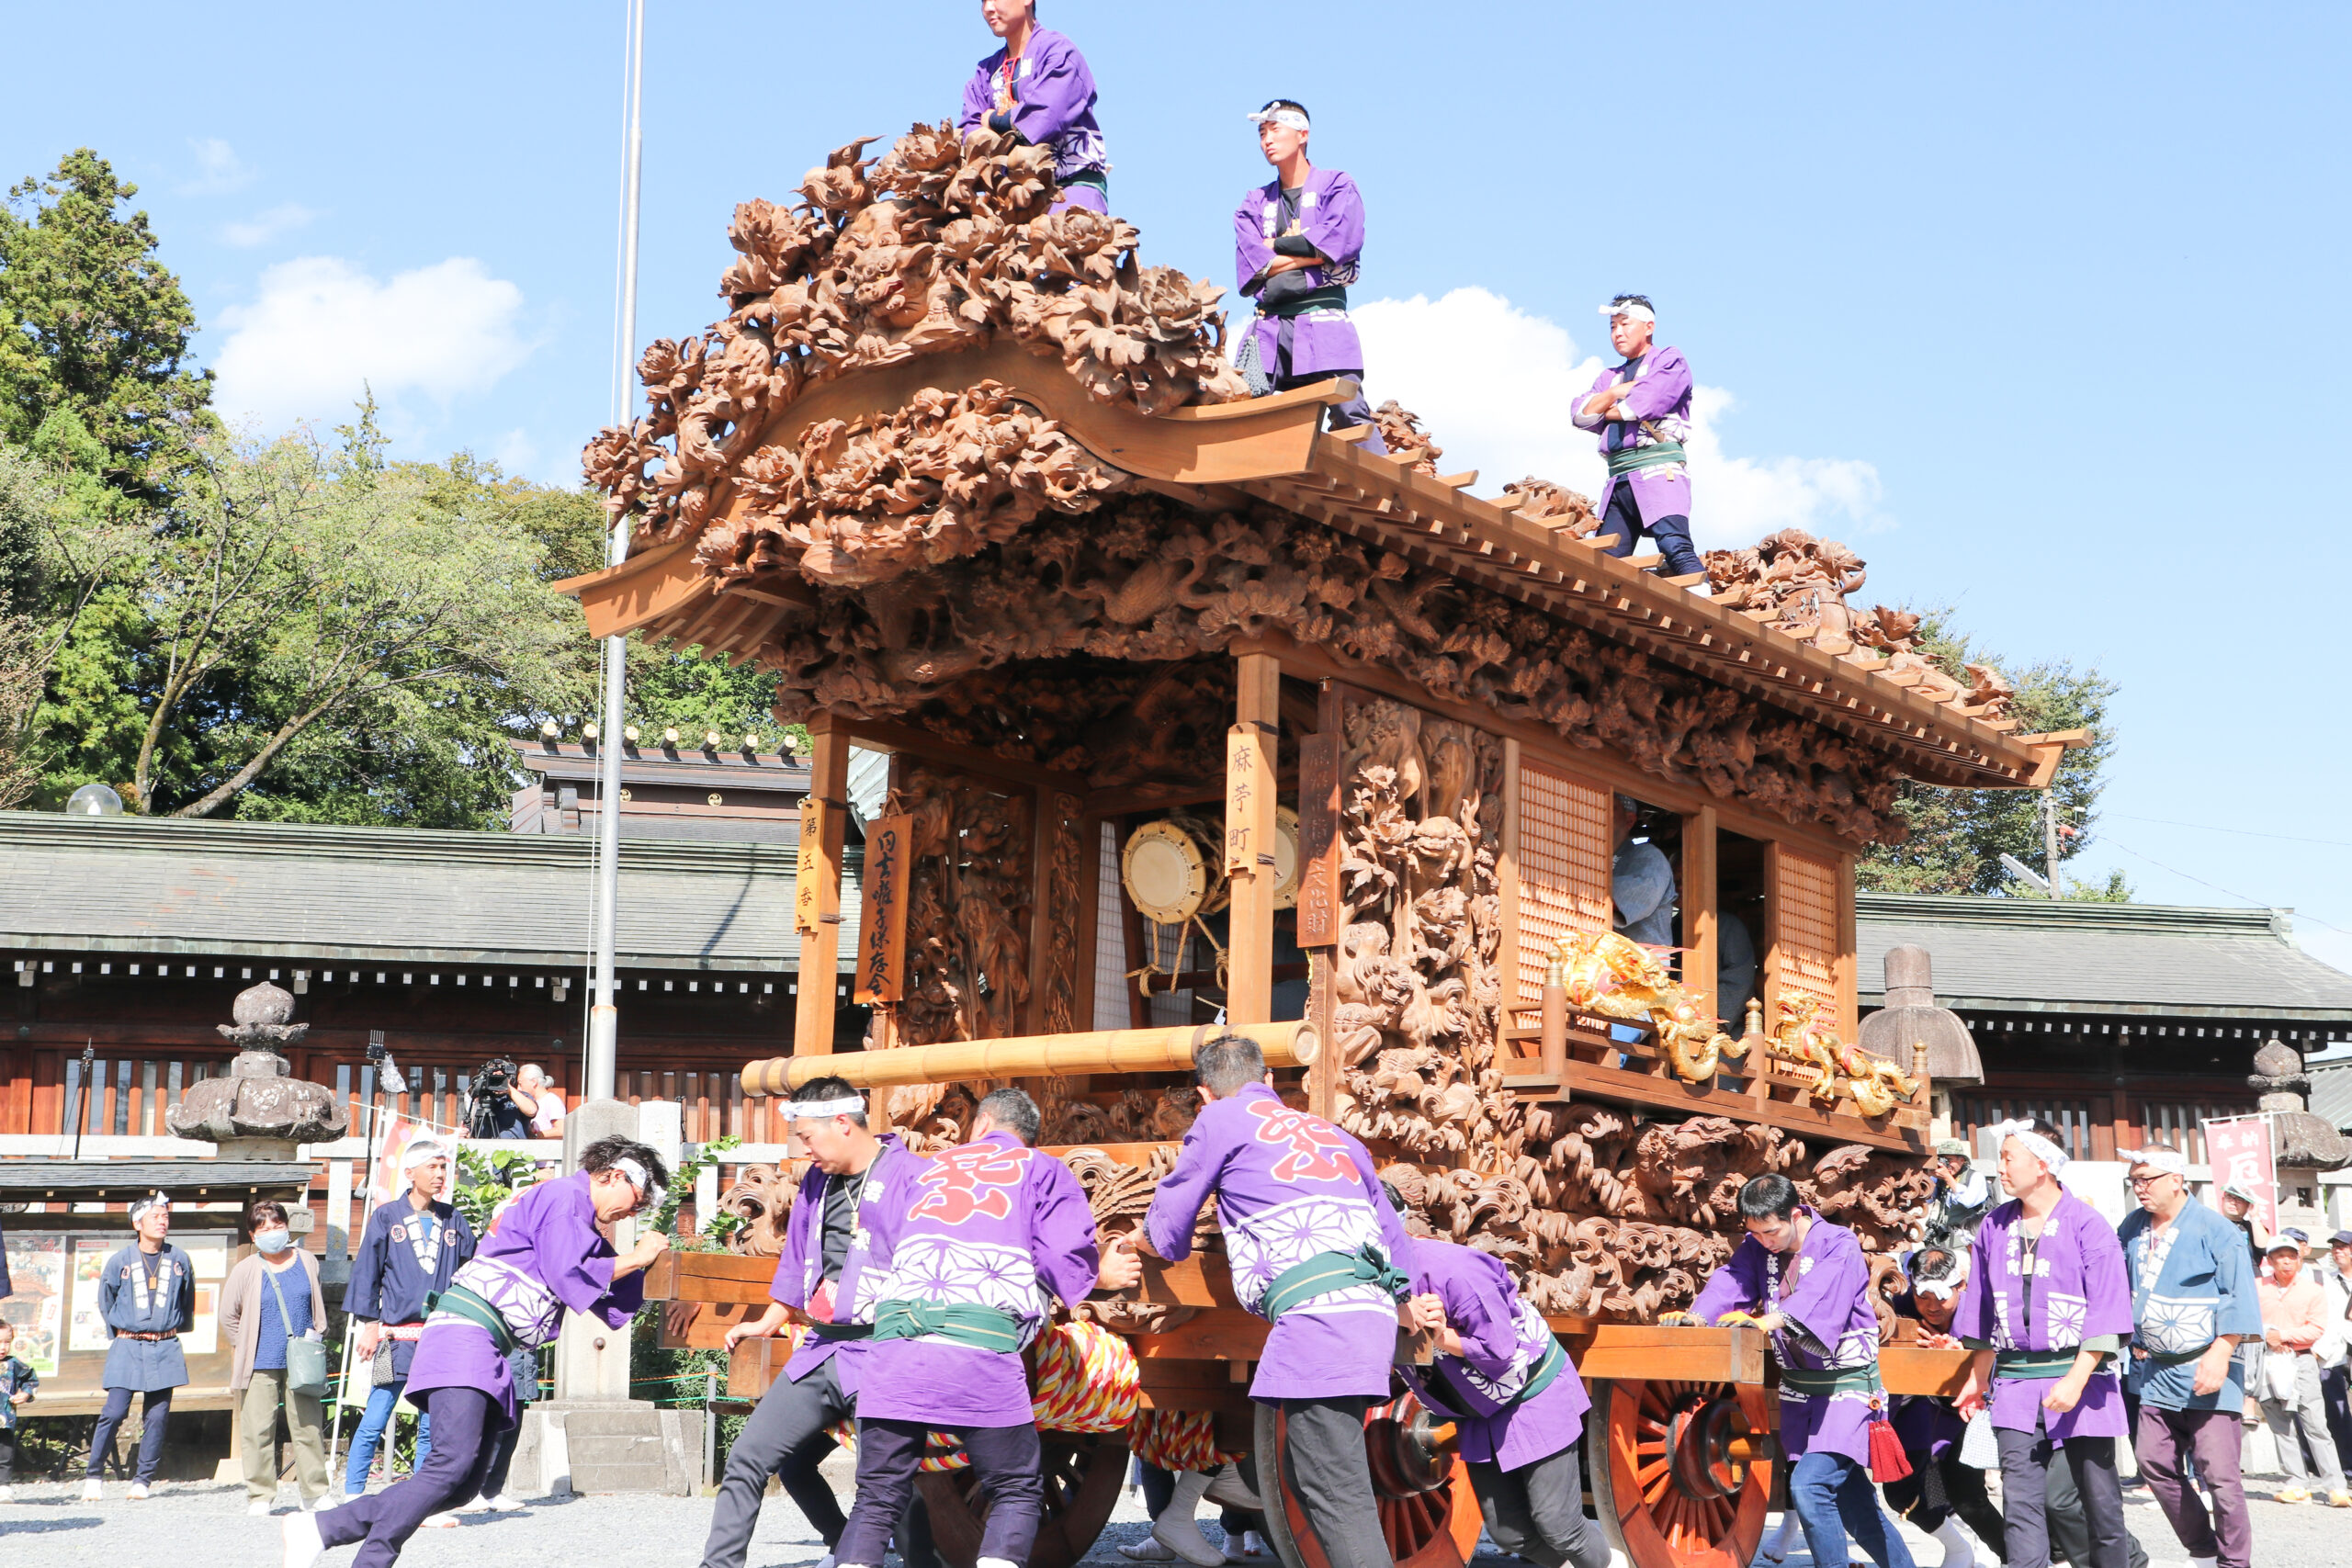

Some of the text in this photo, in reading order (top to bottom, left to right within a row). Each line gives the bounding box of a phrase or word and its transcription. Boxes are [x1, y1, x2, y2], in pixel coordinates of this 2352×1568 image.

[1228, 745, 1253, 852] 麻苧町
[1308, 742, 1329, 933] 鹿沼市指定文化財
[800, 817, 817, 907] 第五番
[2217, 1131, 2259, 1150] 奉納
